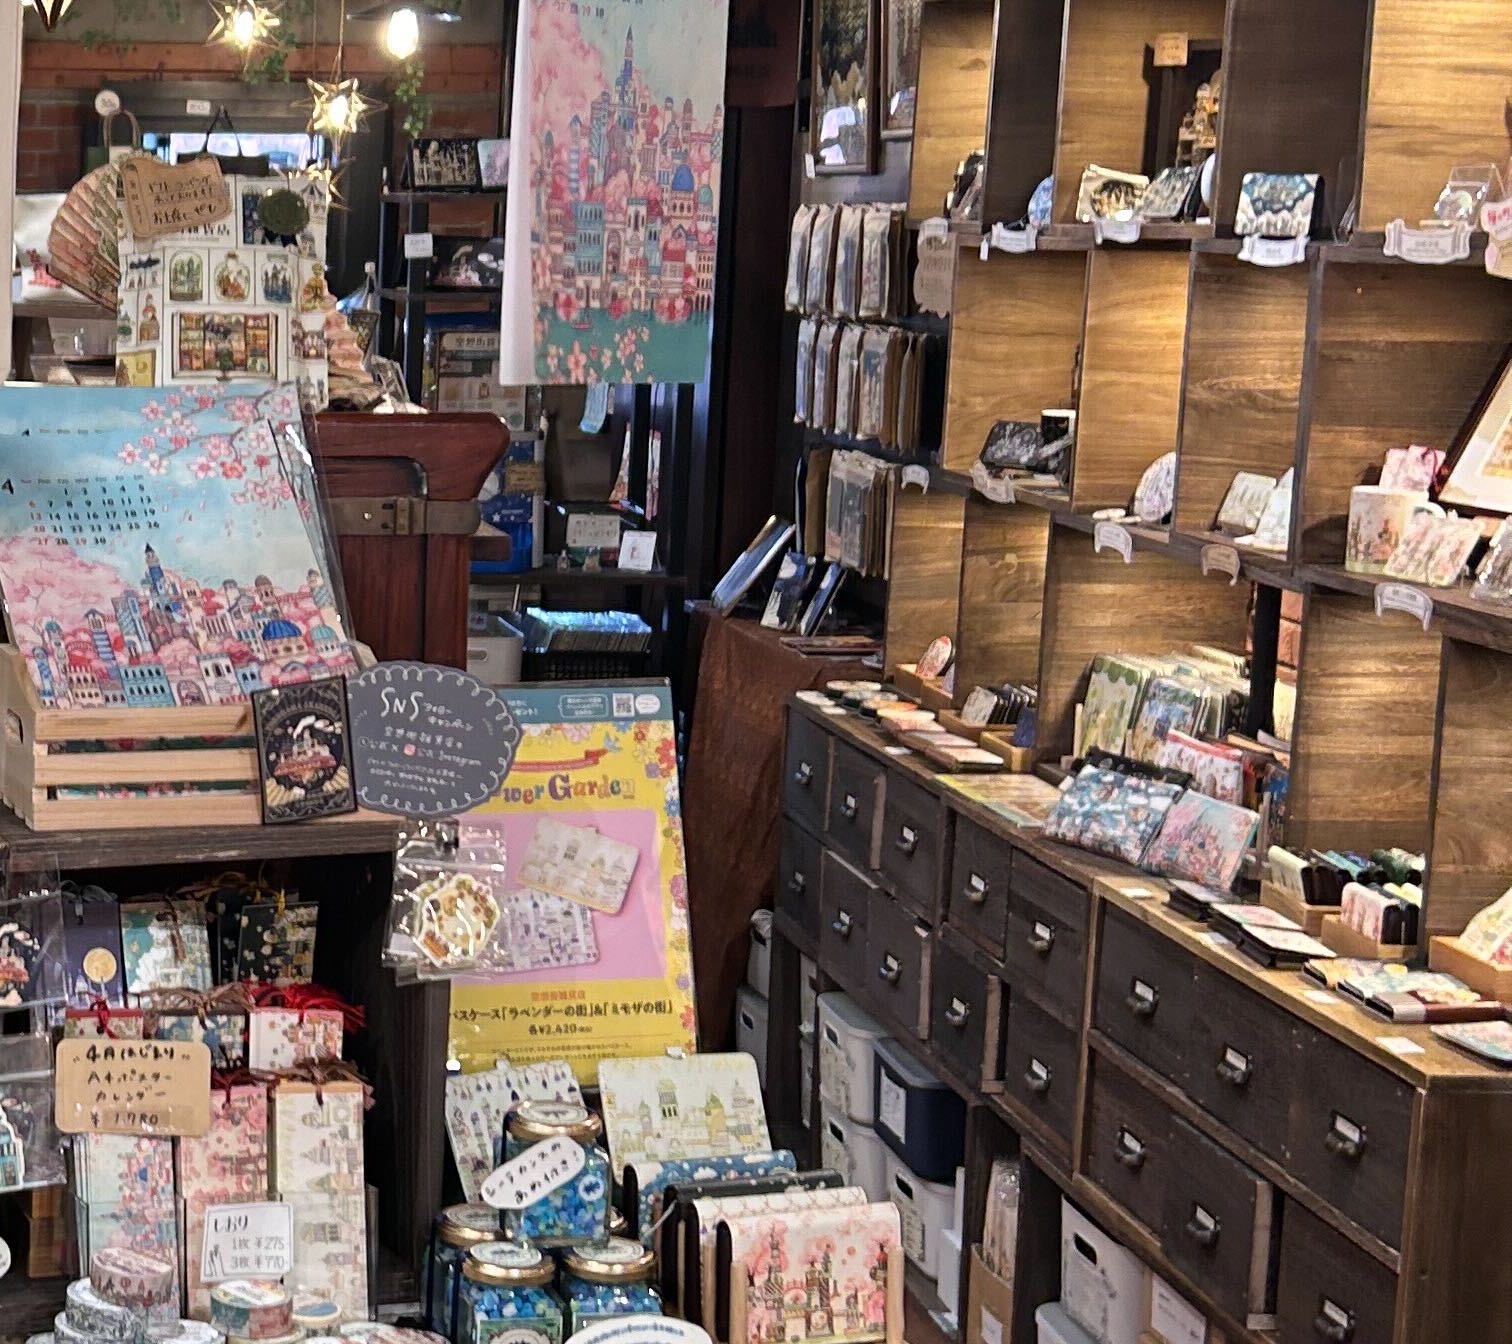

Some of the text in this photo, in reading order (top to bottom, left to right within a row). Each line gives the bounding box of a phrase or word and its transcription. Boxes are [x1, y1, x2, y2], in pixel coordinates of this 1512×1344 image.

[1, 478, 14, 495] 4
[380, 686, 424, 722] SNS
[548, 773, 636, 802] Garden
[213, 1213, 250, 1234] しおり
